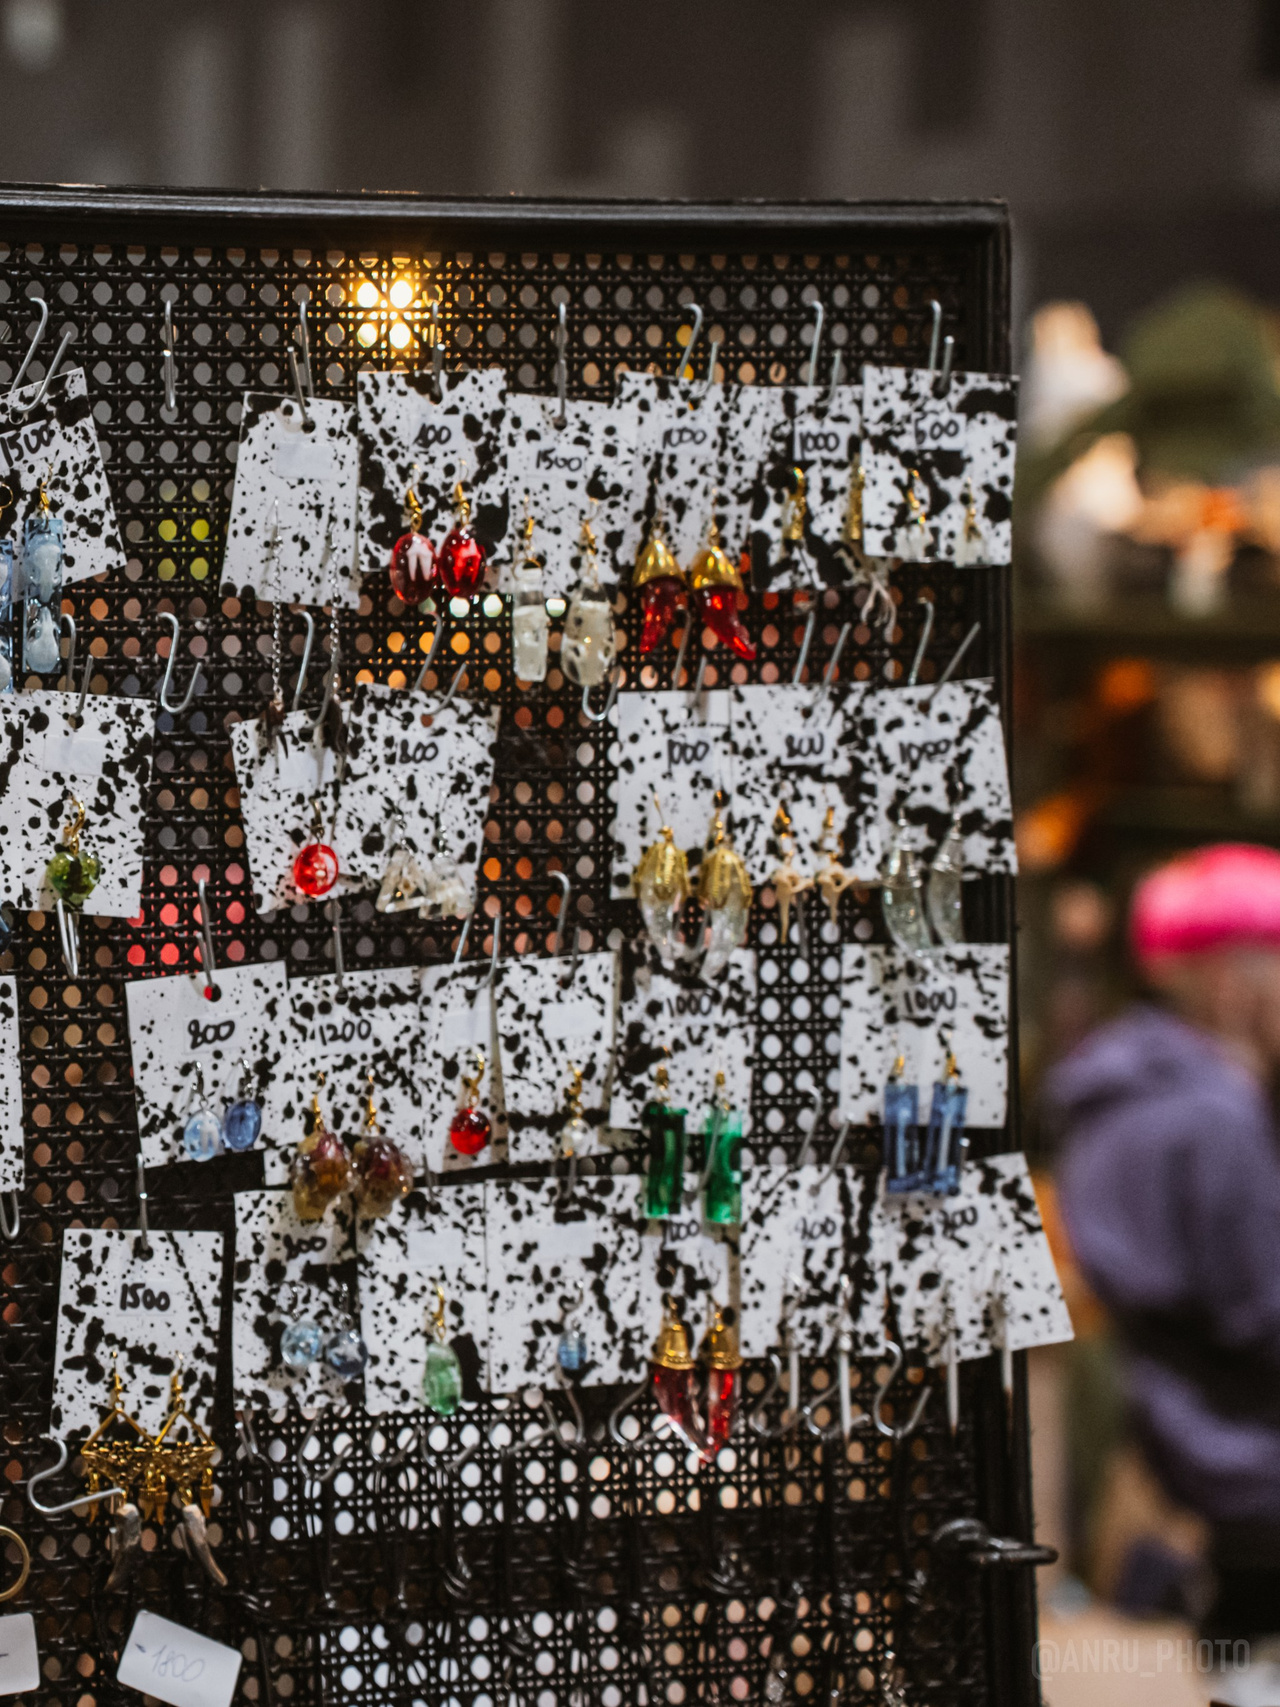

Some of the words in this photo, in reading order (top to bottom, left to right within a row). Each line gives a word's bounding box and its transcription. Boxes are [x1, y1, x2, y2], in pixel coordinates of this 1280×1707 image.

[799, 431, 840, 459] 1000
[536, 448, 582, 471] 1500
[667, 740, 709, 769] 1000
[667, 995, 713, 1016] 1000
[188, 1018, 235, 1049] 800
[319, 1019, 372, 1045] 1200
[120, 1284, 170, 1312] 1500
